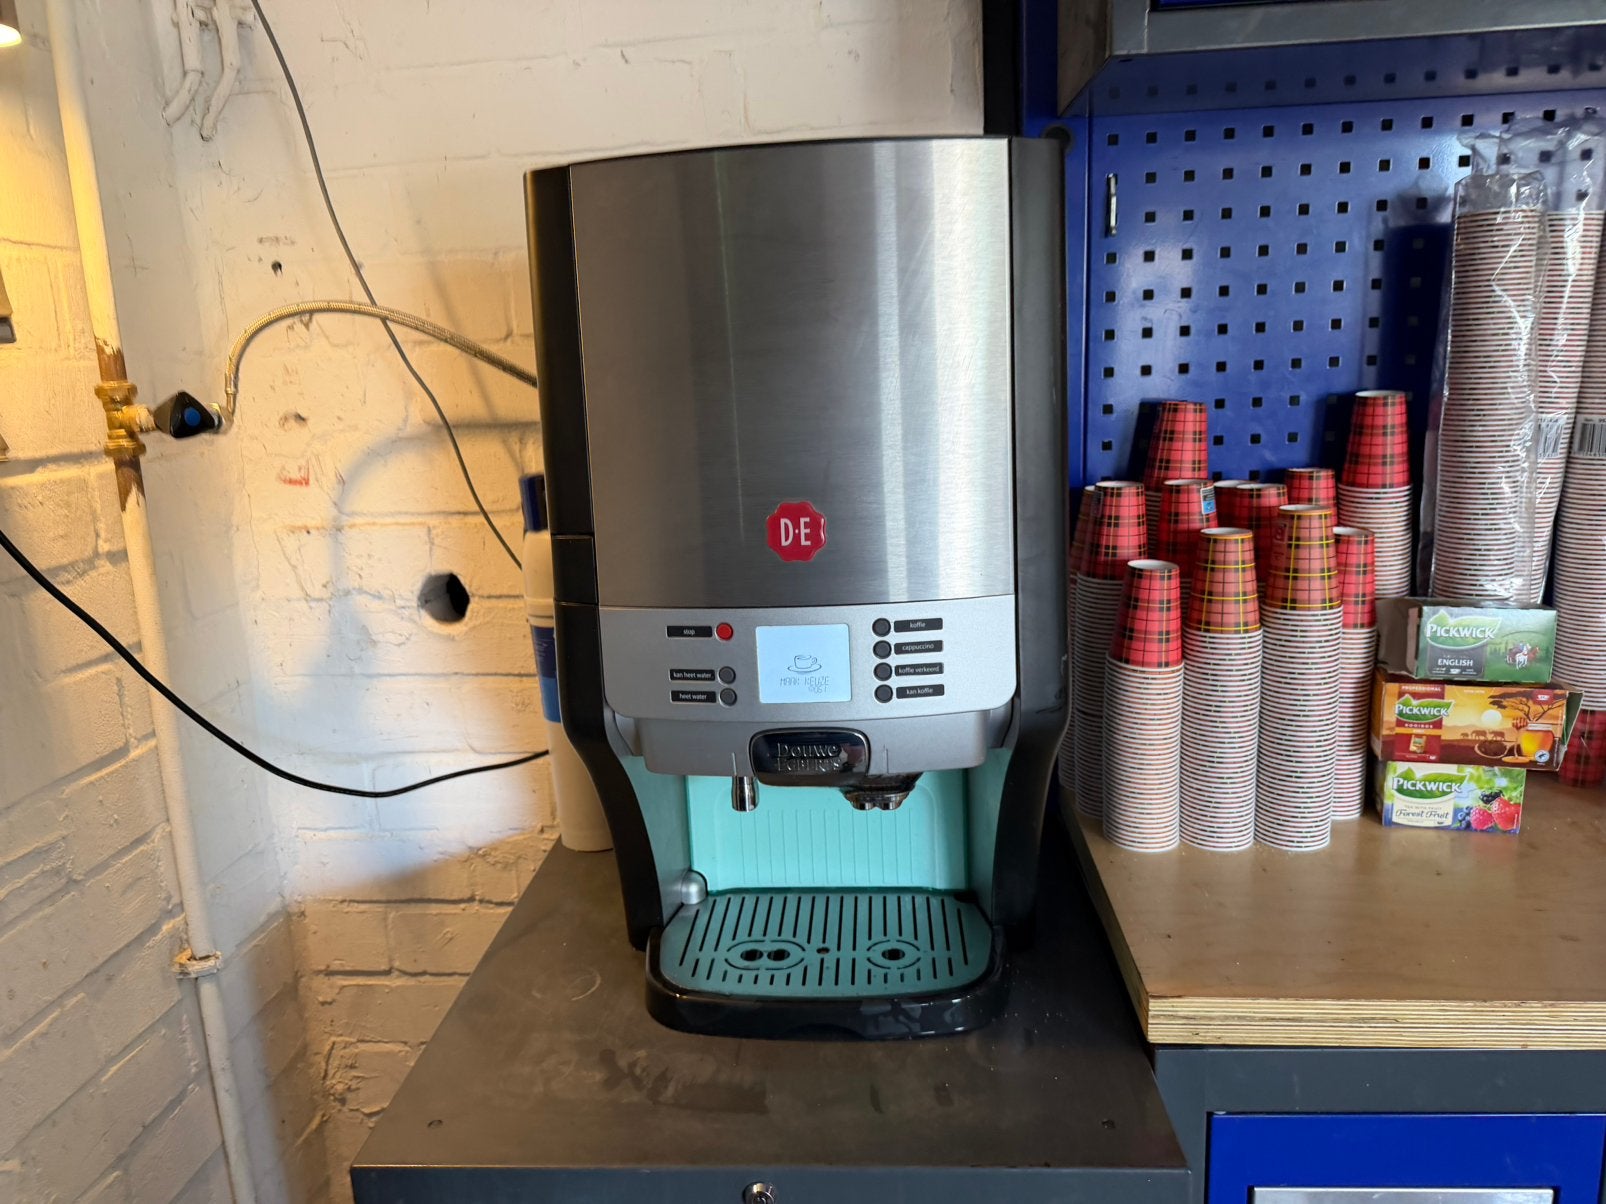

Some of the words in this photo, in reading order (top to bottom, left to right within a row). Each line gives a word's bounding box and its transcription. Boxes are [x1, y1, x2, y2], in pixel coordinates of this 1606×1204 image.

[909, 621, 926, 629] koffie
[902, 643, 935, 652] cappuccino
[1437, 658, 1474, 667] ENGLISH
[915, 665, 940, 673] verkeerd
[683, 671, 697, 679] heet
[906, 688, 917, 696] kan
[917, 687, 934, 695] koffie
[777, 742, 839, 757] Douwe
[1395, 808, 1424, 818] Forest
[1425, 810, 1449, 819] Fruit
